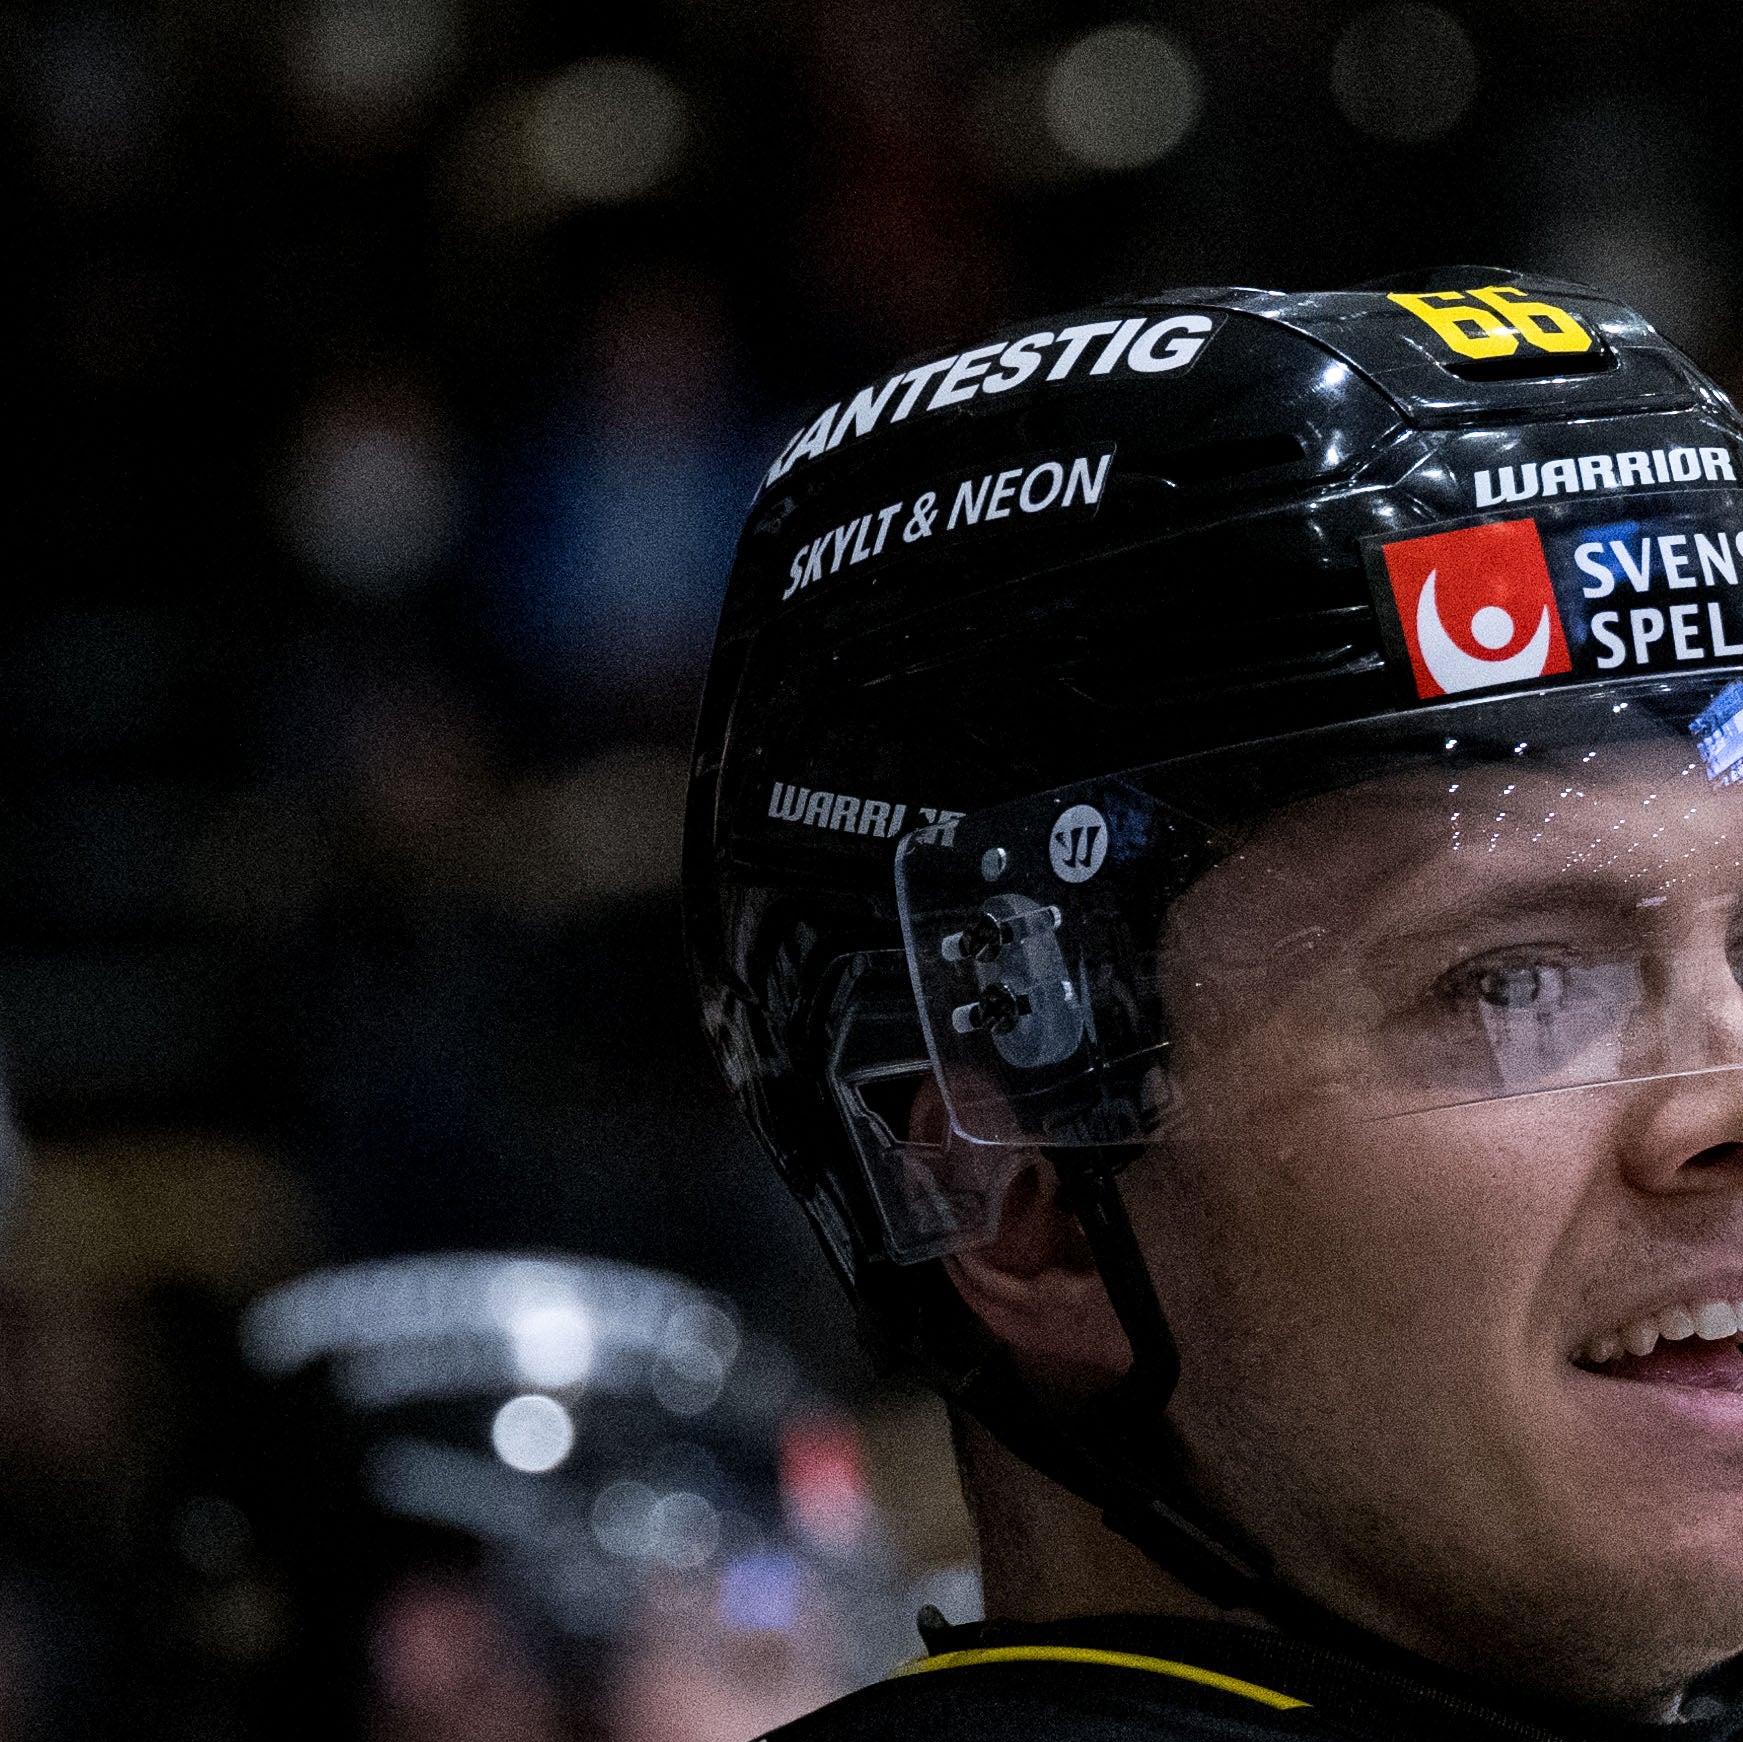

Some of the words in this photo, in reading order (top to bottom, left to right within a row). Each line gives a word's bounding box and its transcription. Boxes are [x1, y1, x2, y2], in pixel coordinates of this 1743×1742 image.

[1387, 286, 1593, 359] 66
[1474, 447, 1736, 508] WARRIOR
[782, 502, 903, 601] SKYLT
[902, 491, 939, 543] &
[946, 455, 1112, 531] NEON
